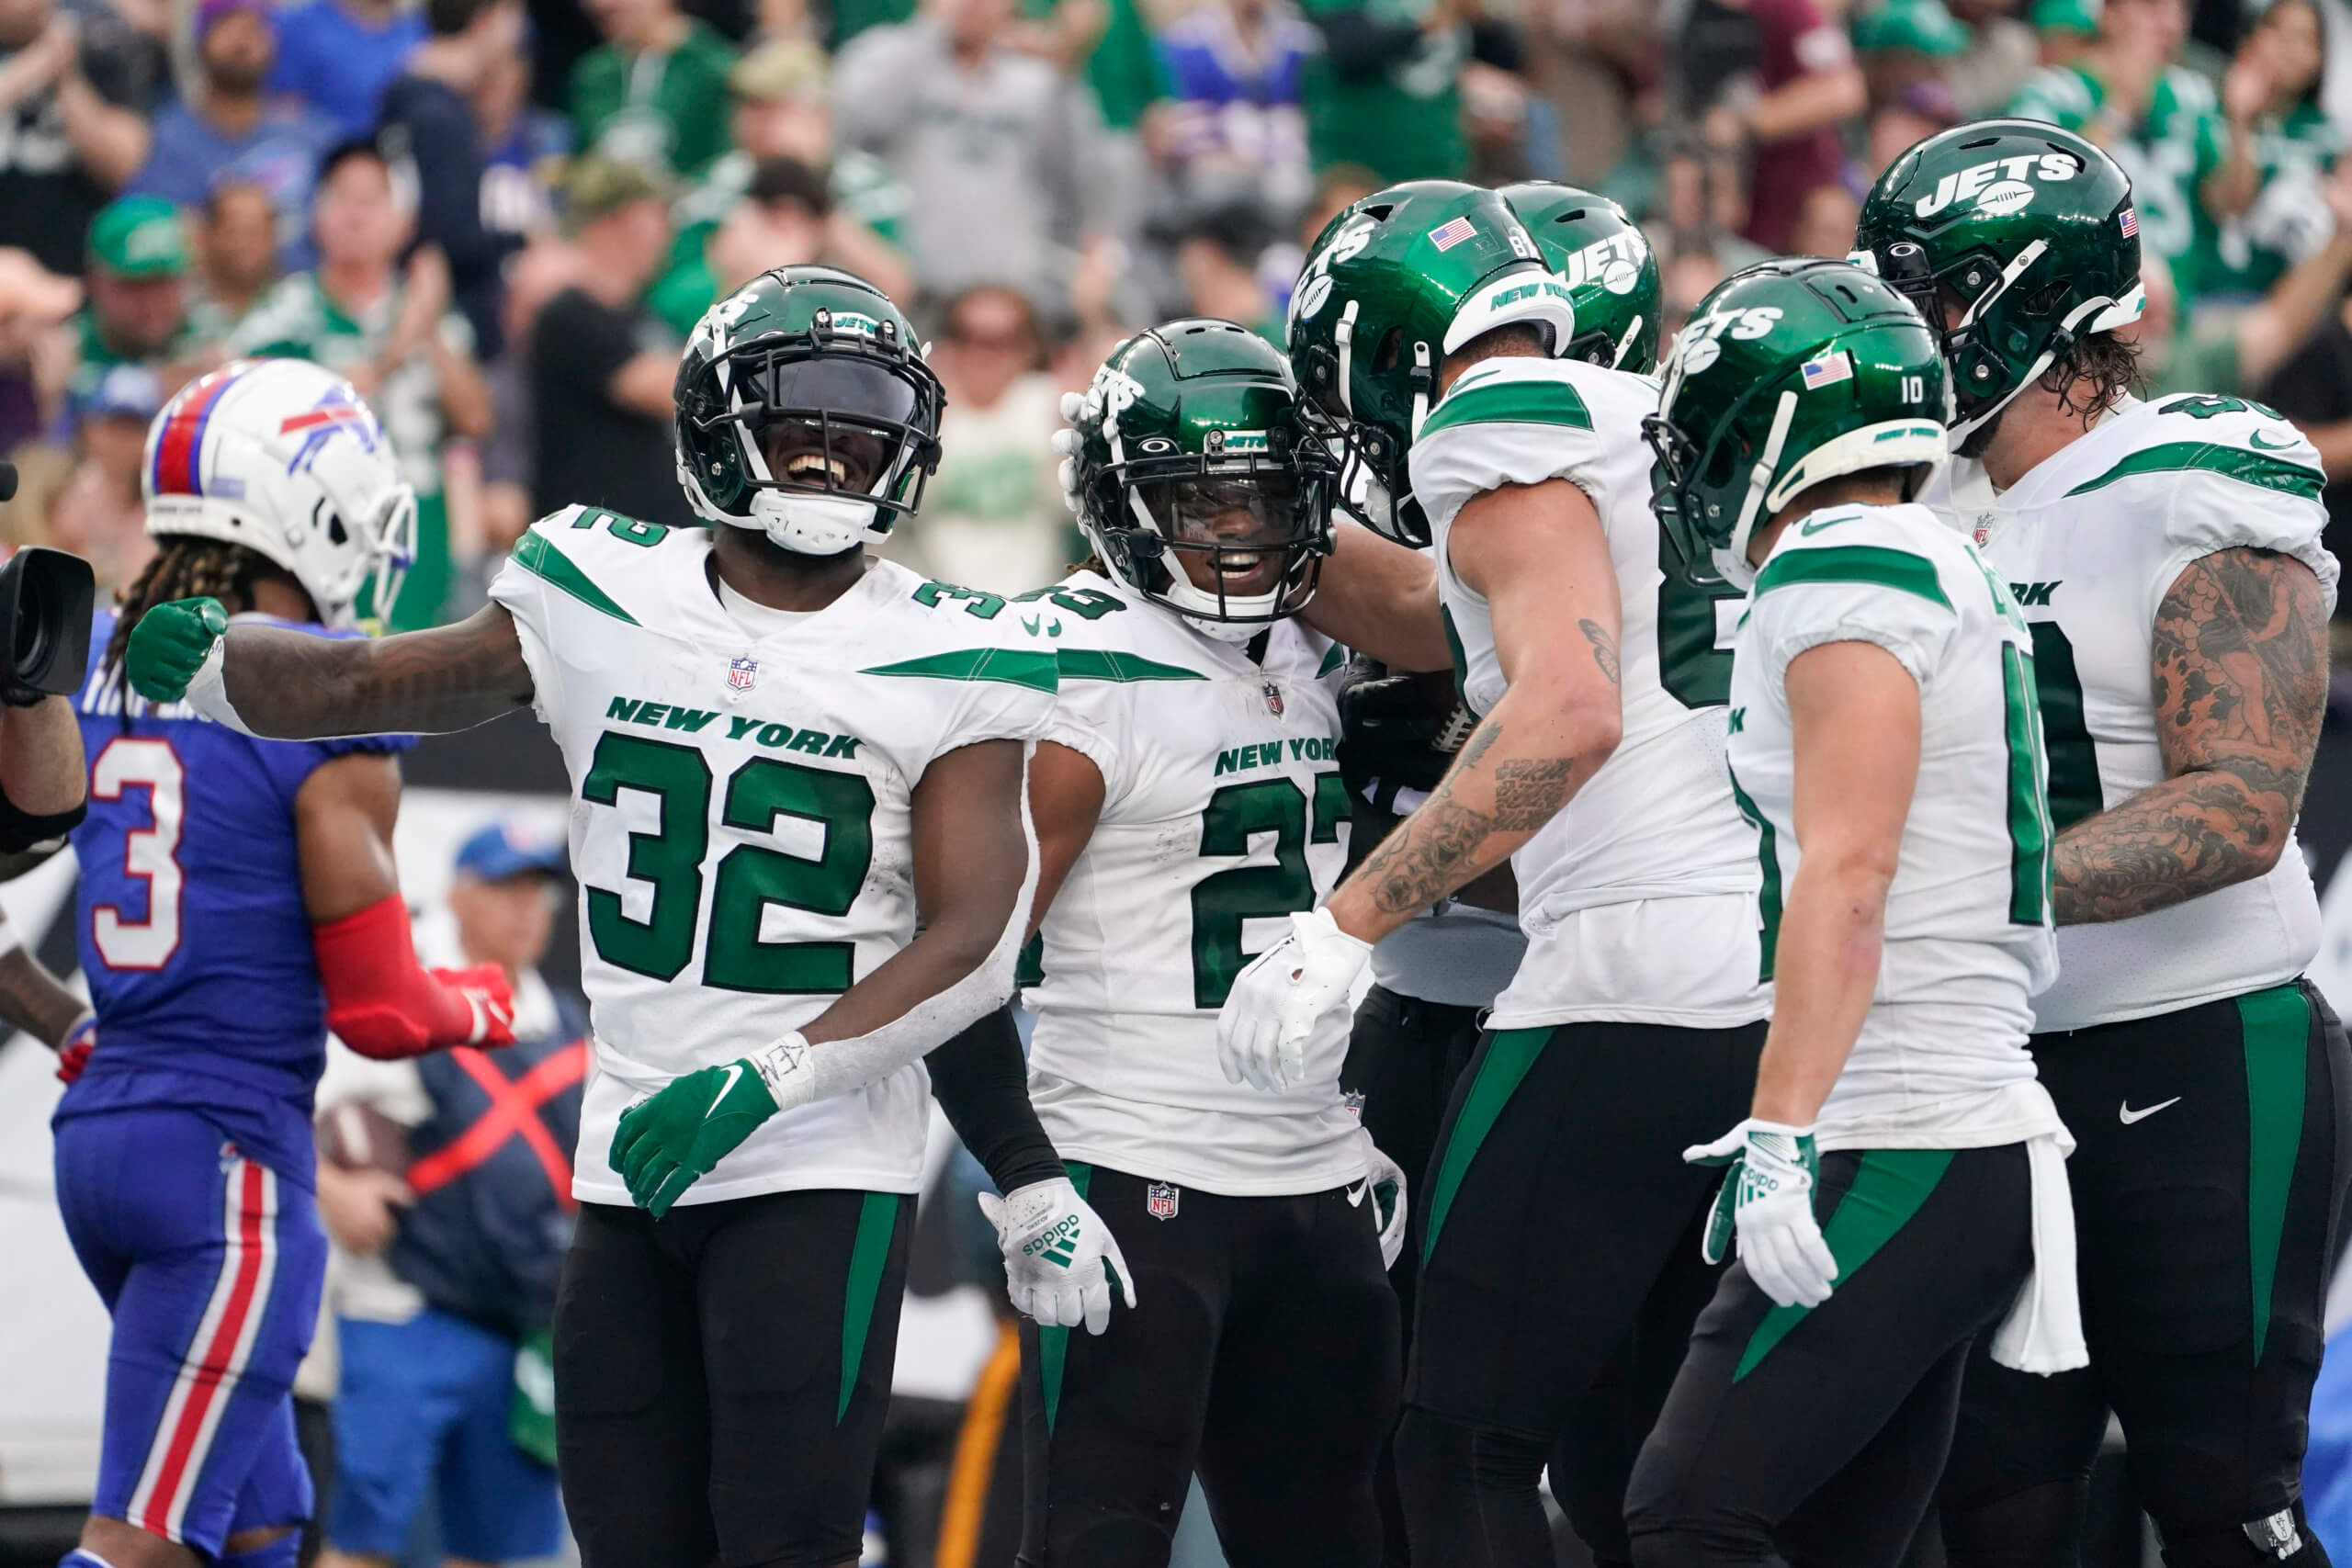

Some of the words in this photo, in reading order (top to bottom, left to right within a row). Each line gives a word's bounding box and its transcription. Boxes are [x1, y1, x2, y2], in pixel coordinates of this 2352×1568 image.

[1916, 153, 2078, 218] JETS
[1490, 282, 1540, 312] NEW
[1901, 376, 1924, 403] 10
[2009, 581, 2064, 606] RK
[729, 669, 752, 686] NFL
[605, 695, 722, 733] NEW
[725, 715, 866, 760] YORK
[1214, 740, 1283, 777] NEW
[1288, 737, 1338, 761] YOR
[91, 738, 186, 971] 3
[581, 729, 876, 995] 32
[1152, 1199, 1174, 1213] NFL
[1022, 1213, 1080, 1256] adidas
